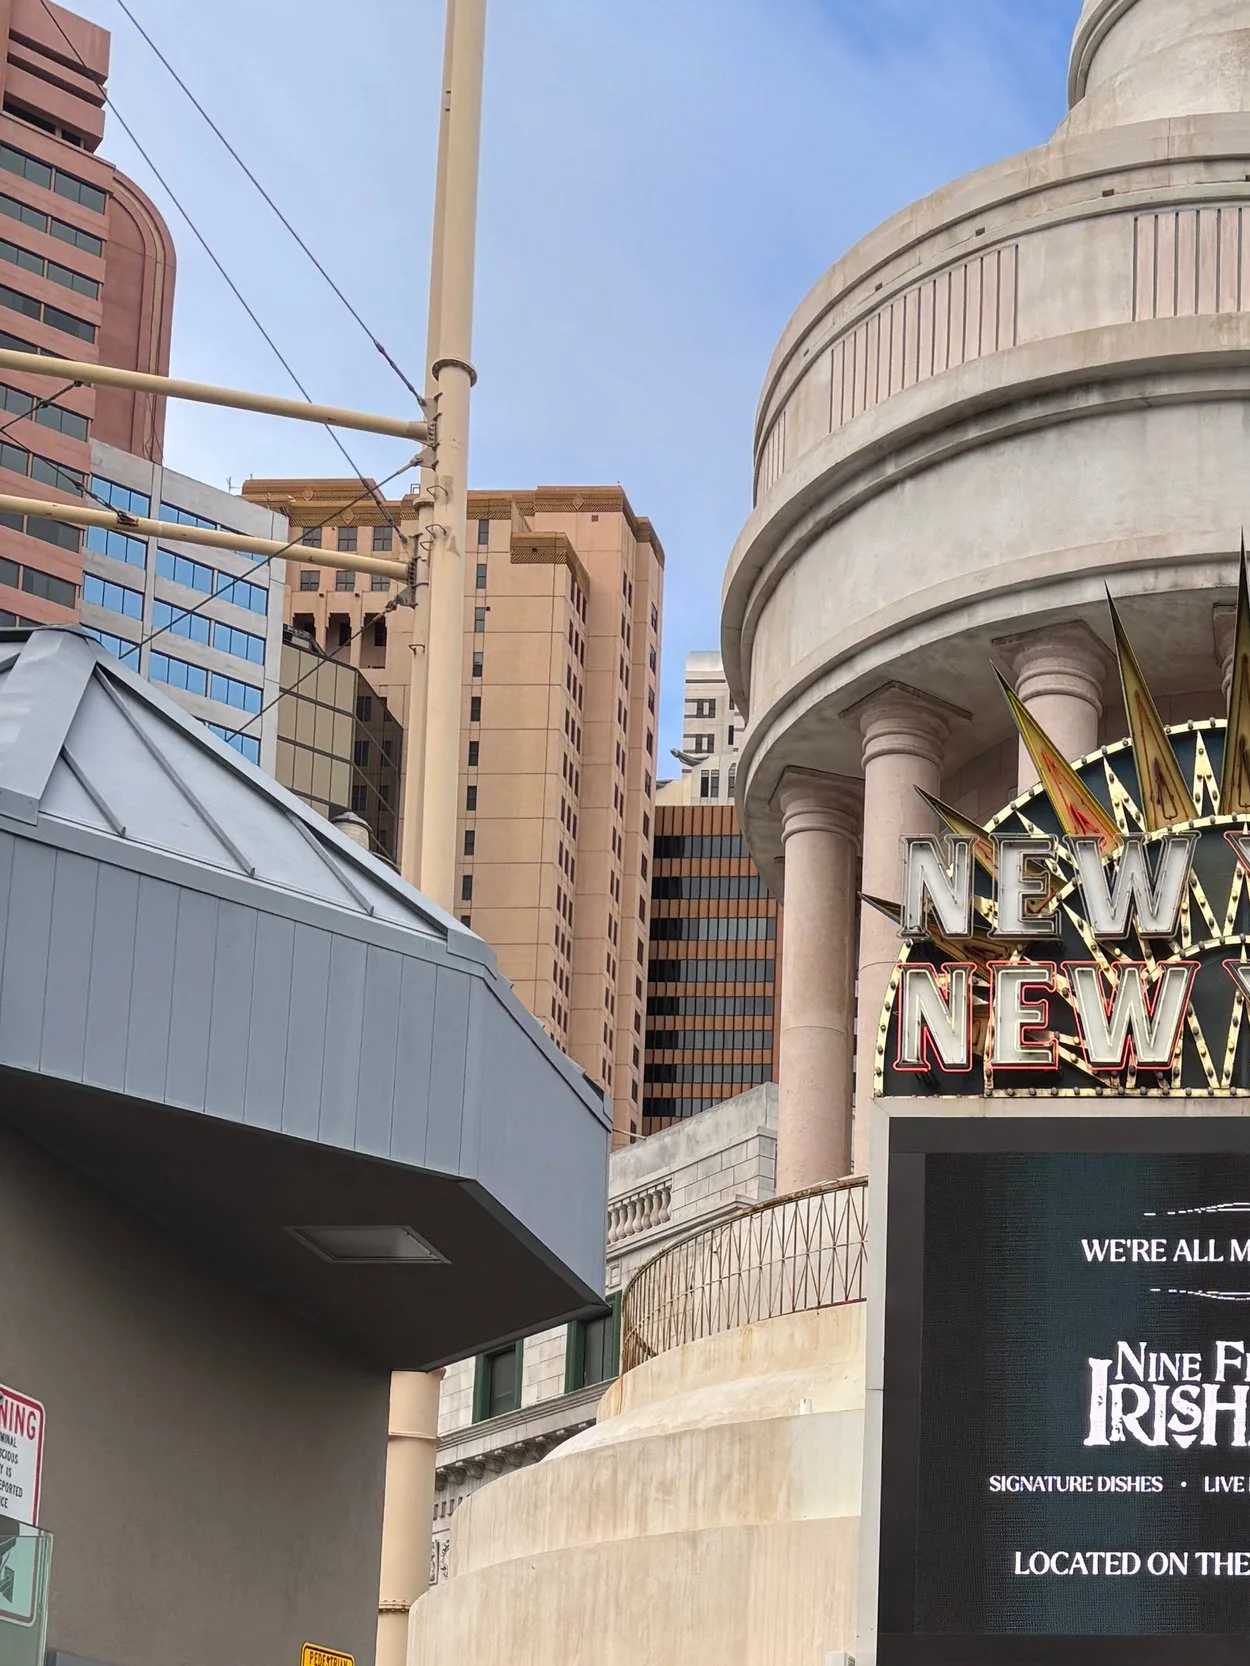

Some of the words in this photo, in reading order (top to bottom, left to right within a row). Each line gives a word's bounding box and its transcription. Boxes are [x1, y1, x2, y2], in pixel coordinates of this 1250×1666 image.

[899, 831, 1202, 940] NEW
[892, 961, 1202, 1072] NEW
[1081, 1239, 1167, 1262] WE'RE
[1173, 1239, 1224, 1262] ALL
[990, 1475, 1093, 1492] SIGNATURE
[1098, 1476, 1163, 1492] DISHES
[1205, 1476, 1245, 1492] LIVE
[1015, 1551, 1141, 1575] LOCATED
[1147, 1552, 1188, 1575] ON
[1195, 1552, 1250, 1575] THE
